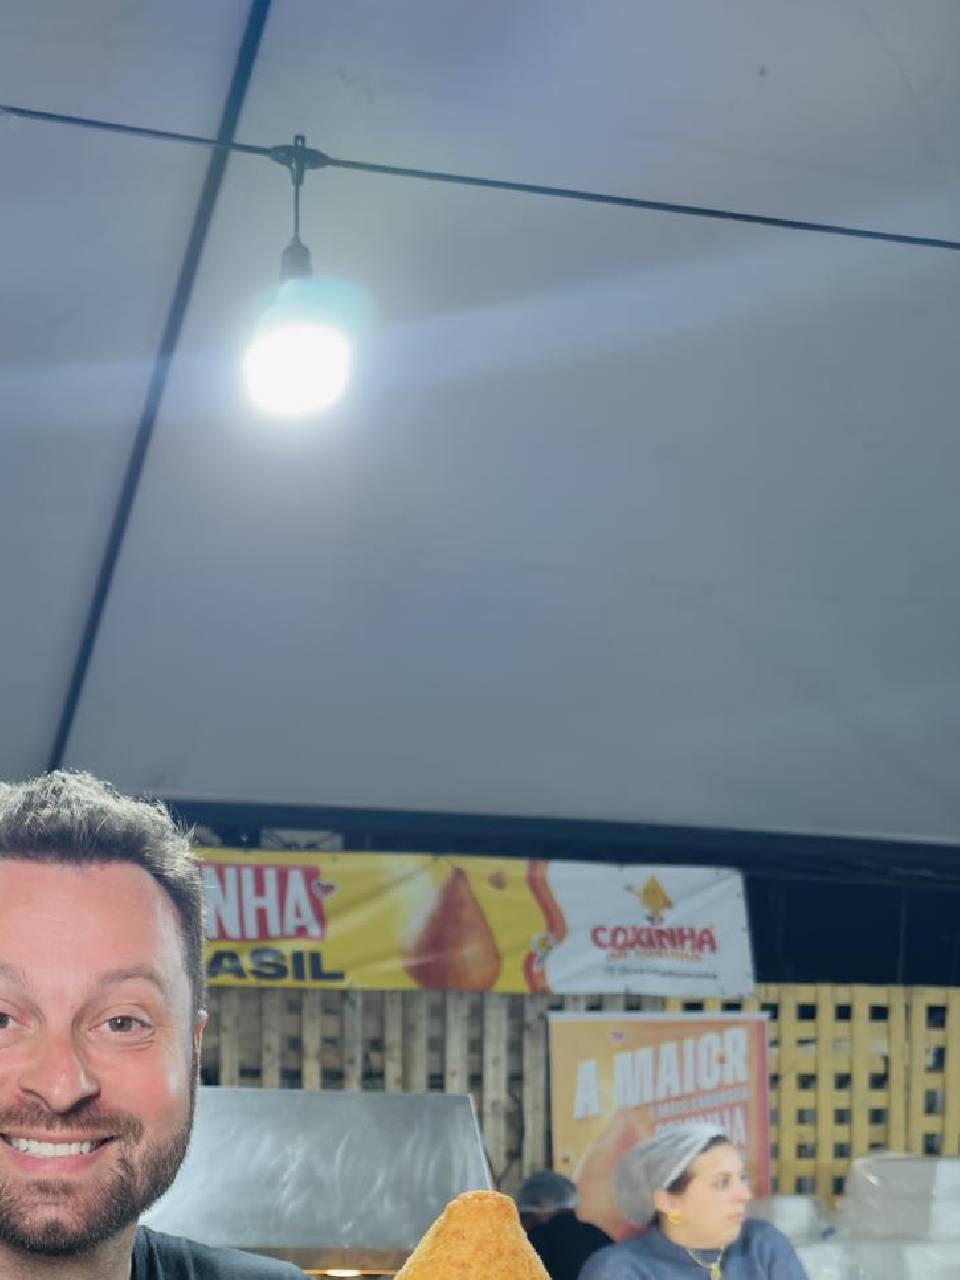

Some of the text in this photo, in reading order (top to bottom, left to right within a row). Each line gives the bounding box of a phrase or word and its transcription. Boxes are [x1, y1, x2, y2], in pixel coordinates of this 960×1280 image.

[201, 866, 323, 939] NHA
[590, 924, 718, 954] COXINHA
[205, 948, 346, 981] ASIL
[572, 1059, 601, 1120] A
